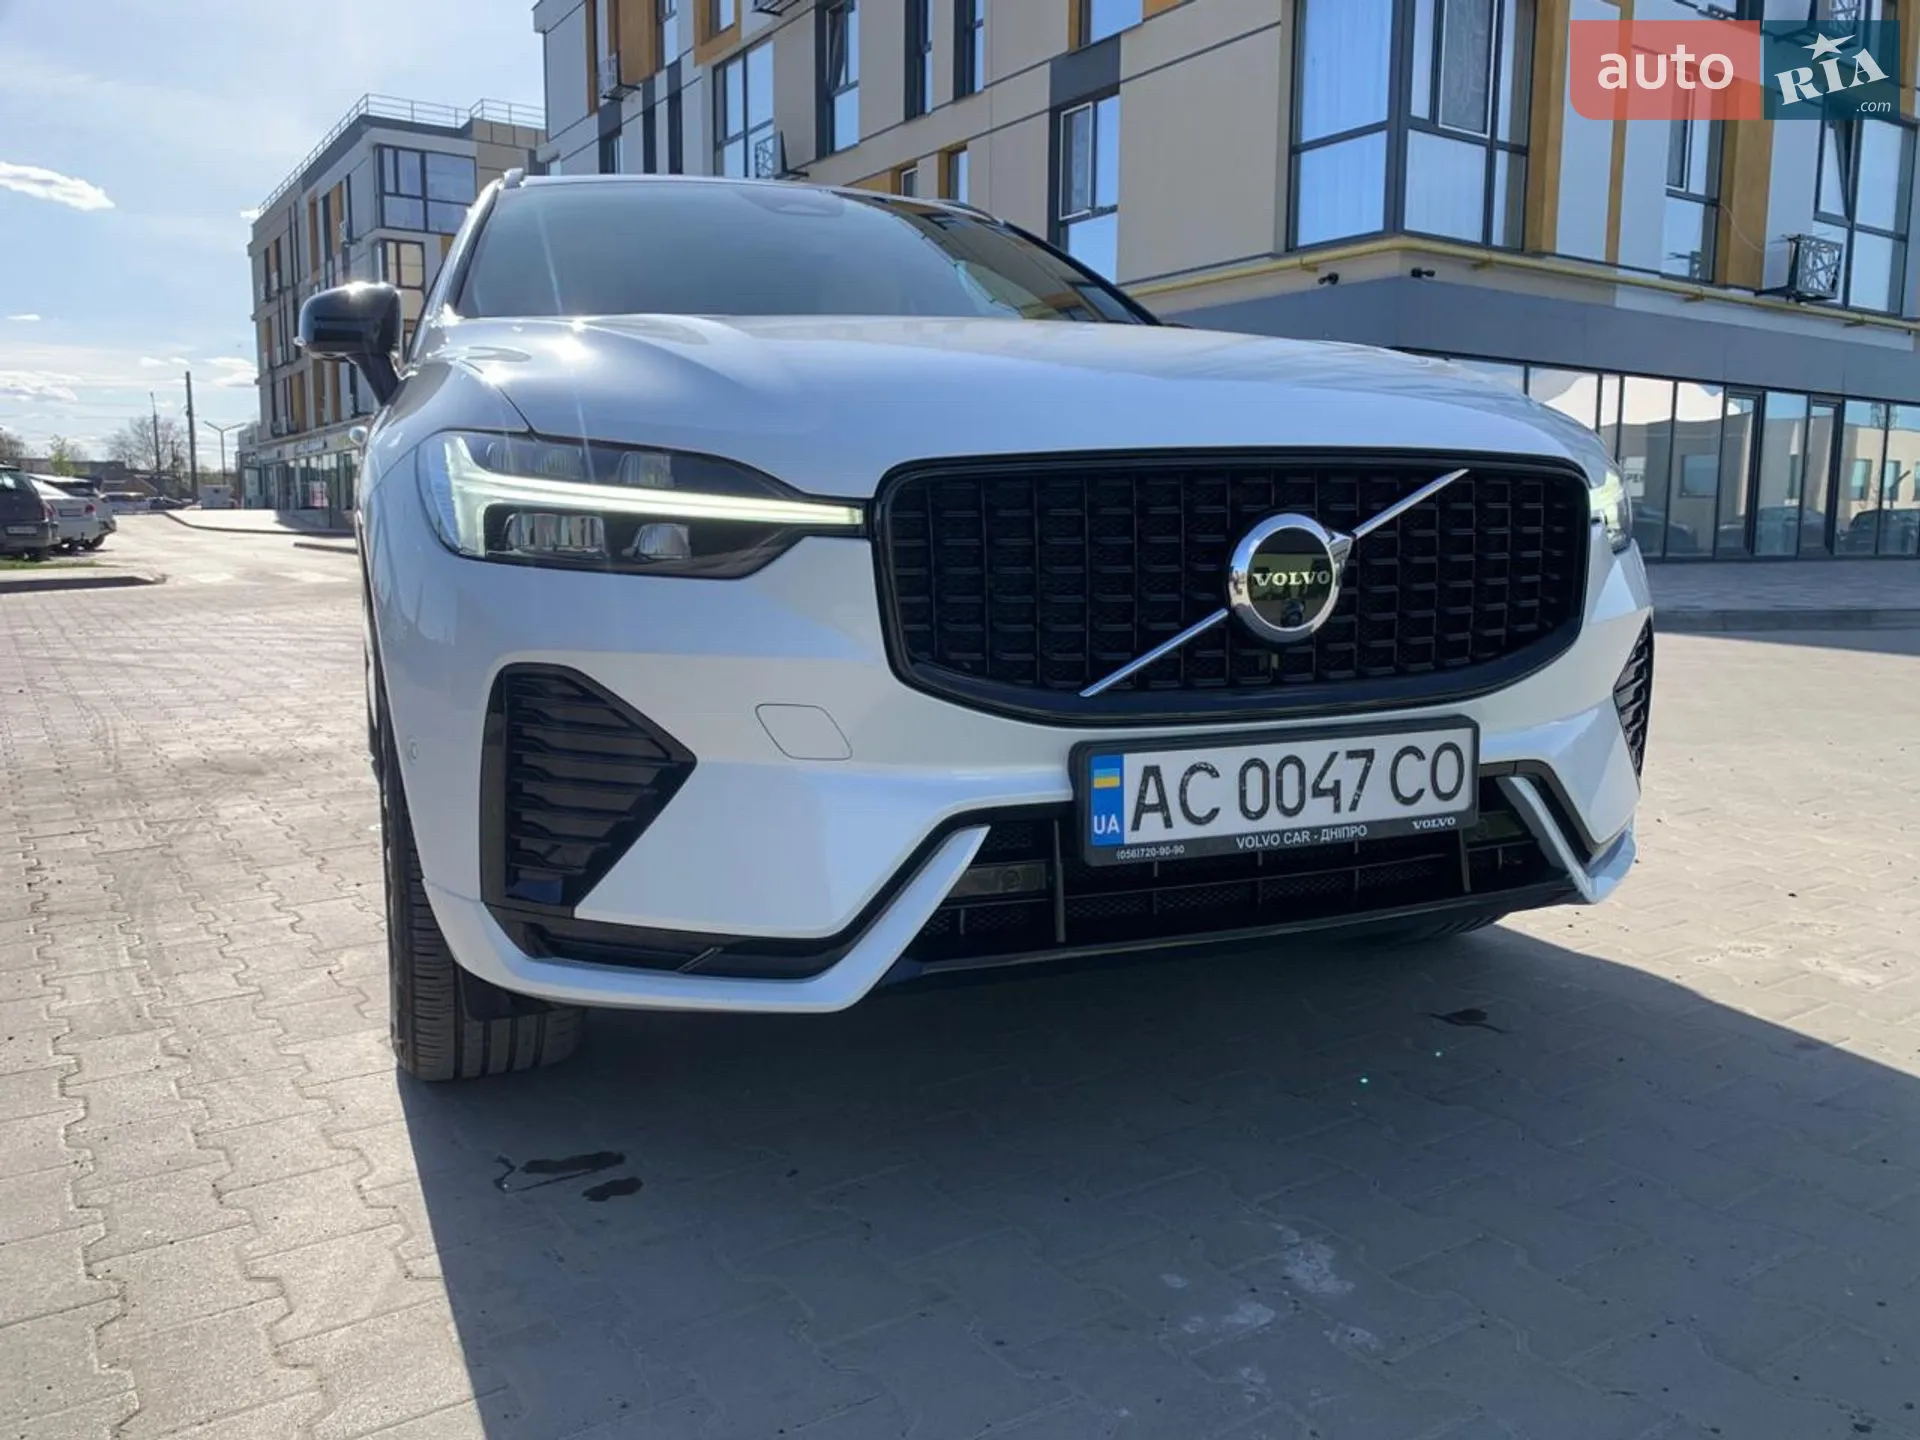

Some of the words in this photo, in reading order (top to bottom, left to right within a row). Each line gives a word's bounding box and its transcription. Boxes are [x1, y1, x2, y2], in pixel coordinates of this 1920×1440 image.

[1253, 570, 1330, 587] VOLVO
[1131, 761, 1221, 832] AC
[1238, 748, 1376, 821] 0047
[1389, 741, 1465, 806] CO
[1093, 814, 1120, 835] UA
[1412, 816, 1457, 830] VOLVO
[1236, 832, 1280, 849] VOLVO
[1283, 829, 1311, 845] CAR
[1320, 824, 1369, 842] ДНІПРО
